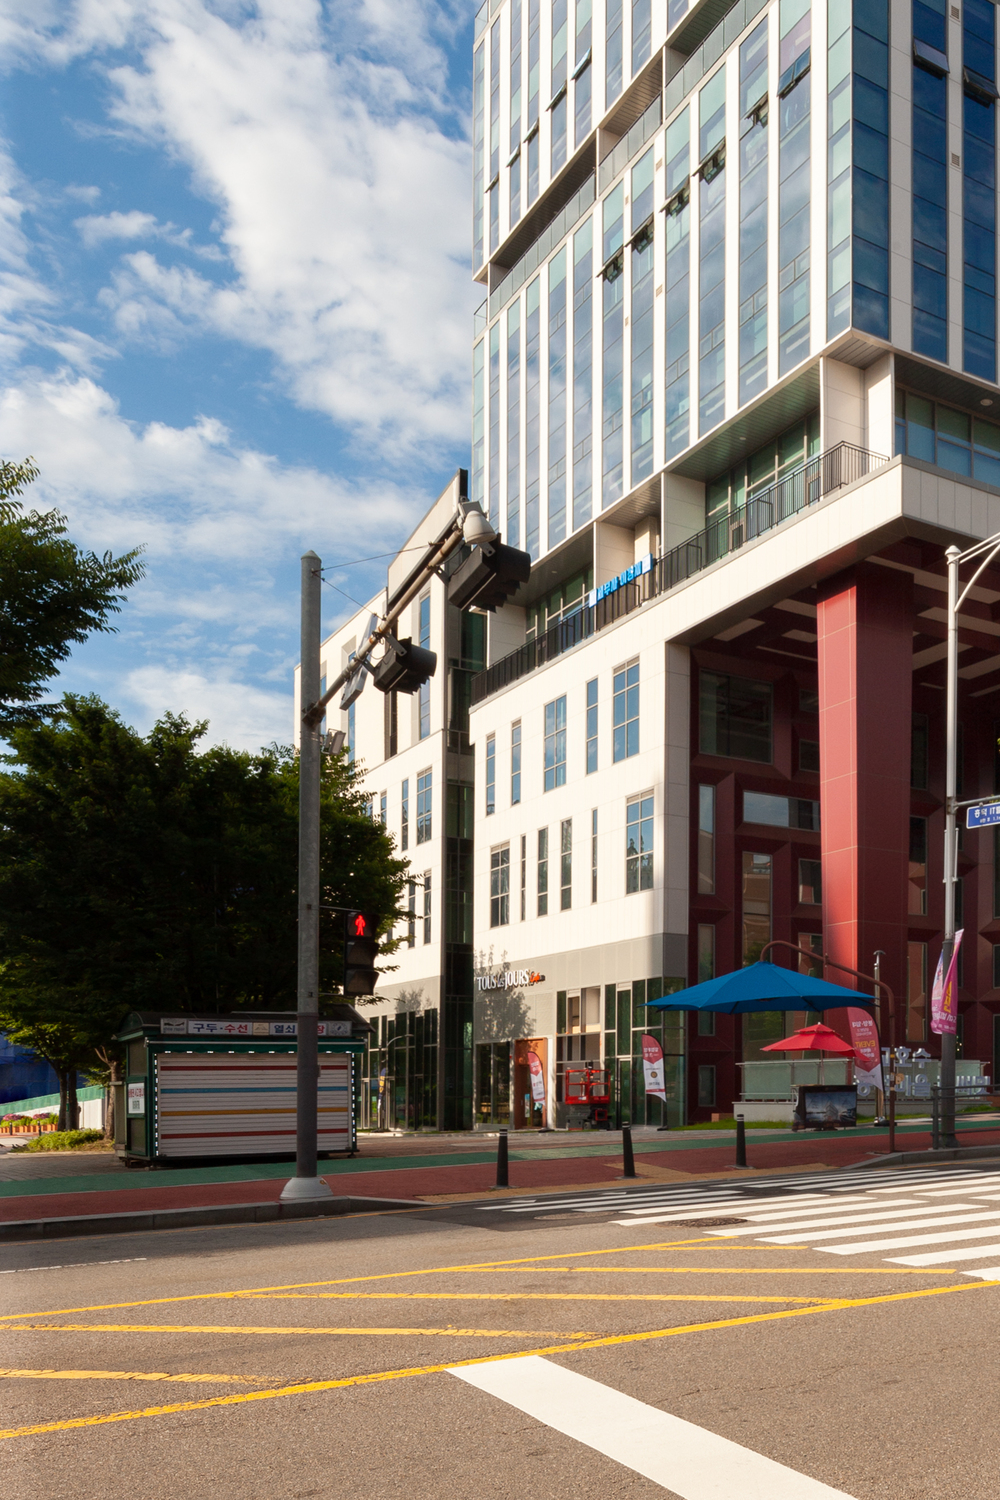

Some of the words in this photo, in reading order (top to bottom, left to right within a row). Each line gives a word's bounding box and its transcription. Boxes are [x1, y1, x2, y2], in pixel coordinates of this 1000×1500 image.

[477, 974, 497, 991] TOUS
[504, 969, 530, 991] JOURS
[274, 1024, 296, 1034] 열쇠
